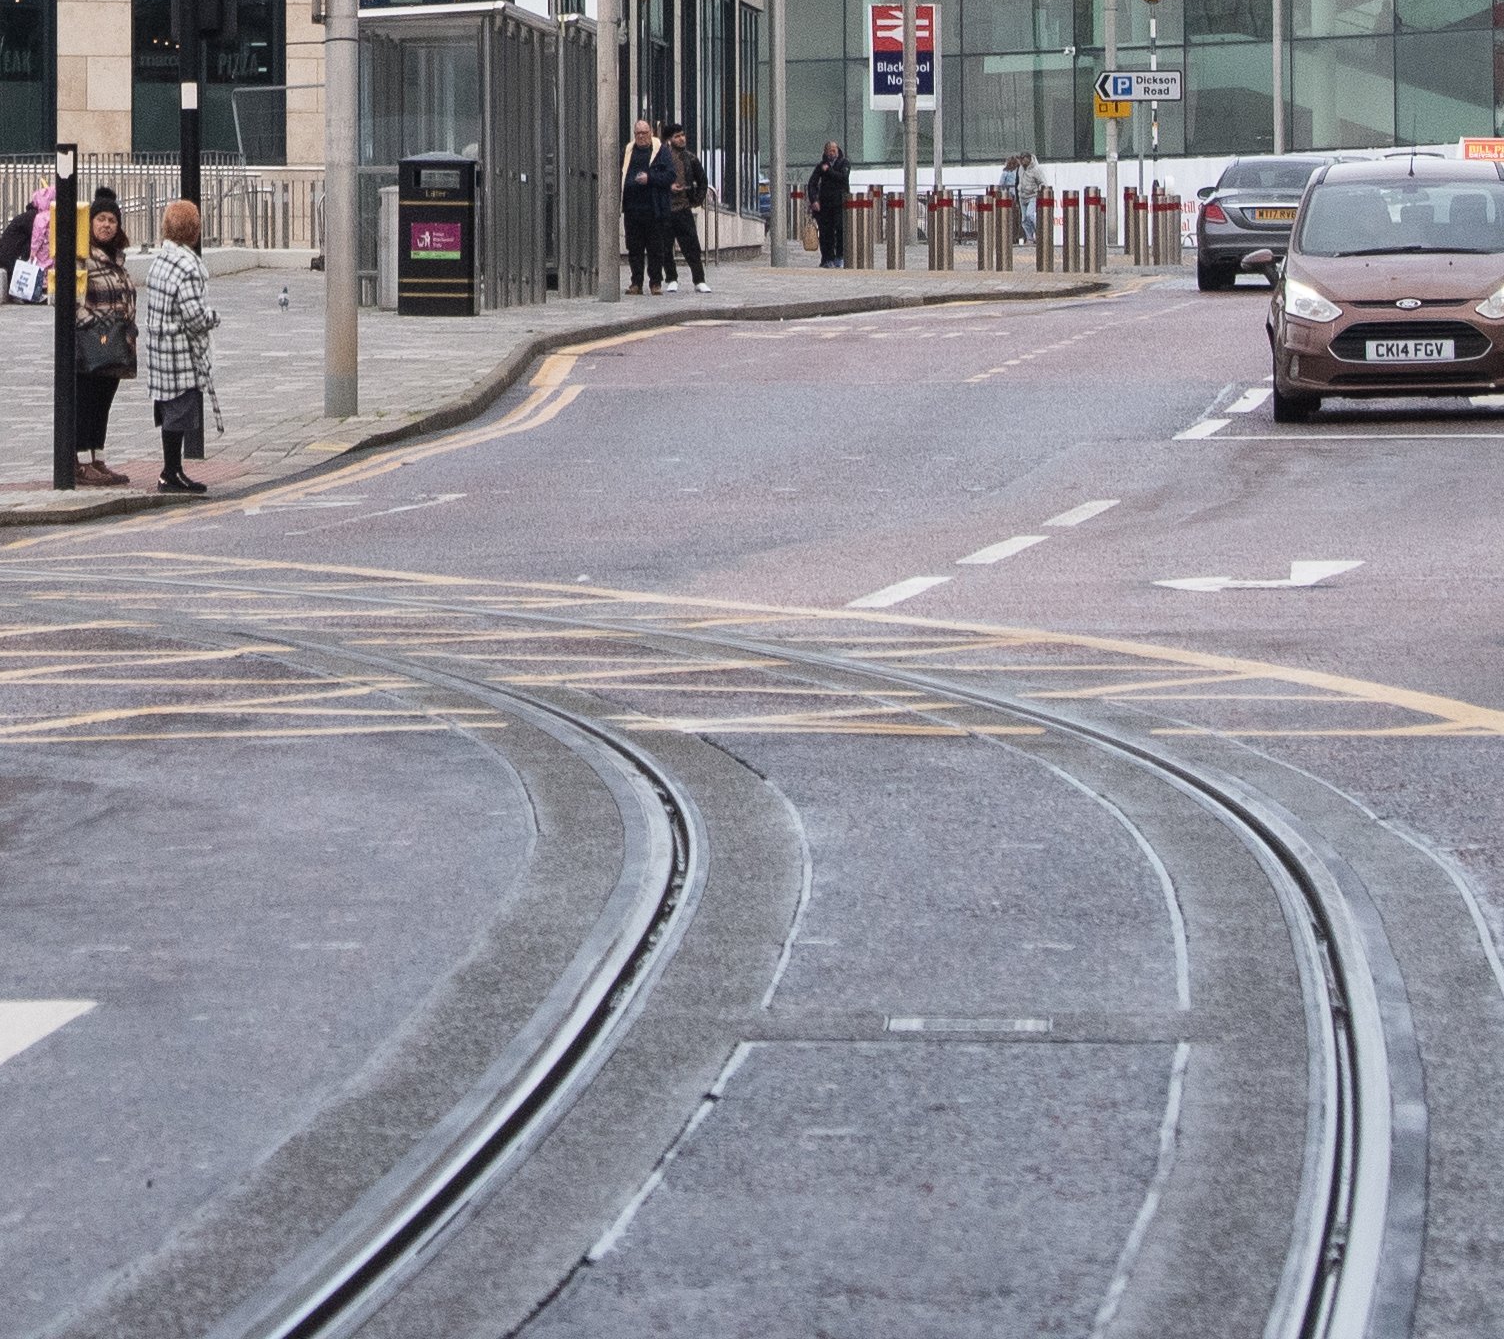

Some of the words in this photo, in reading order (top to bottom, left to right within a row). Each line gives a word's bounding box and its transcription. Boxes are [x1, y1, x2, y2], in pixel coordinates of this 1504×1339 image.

[877, 61, 930, 73] Blackol
[1136, 76, 1177, 85] Dickson
[1143, 87, 1170, 95] Road
[1468, 145, 1490, 153] BILL
[1375, 343, 1409, 357] CK14
[1414, 342, 1444, 357] FGV
